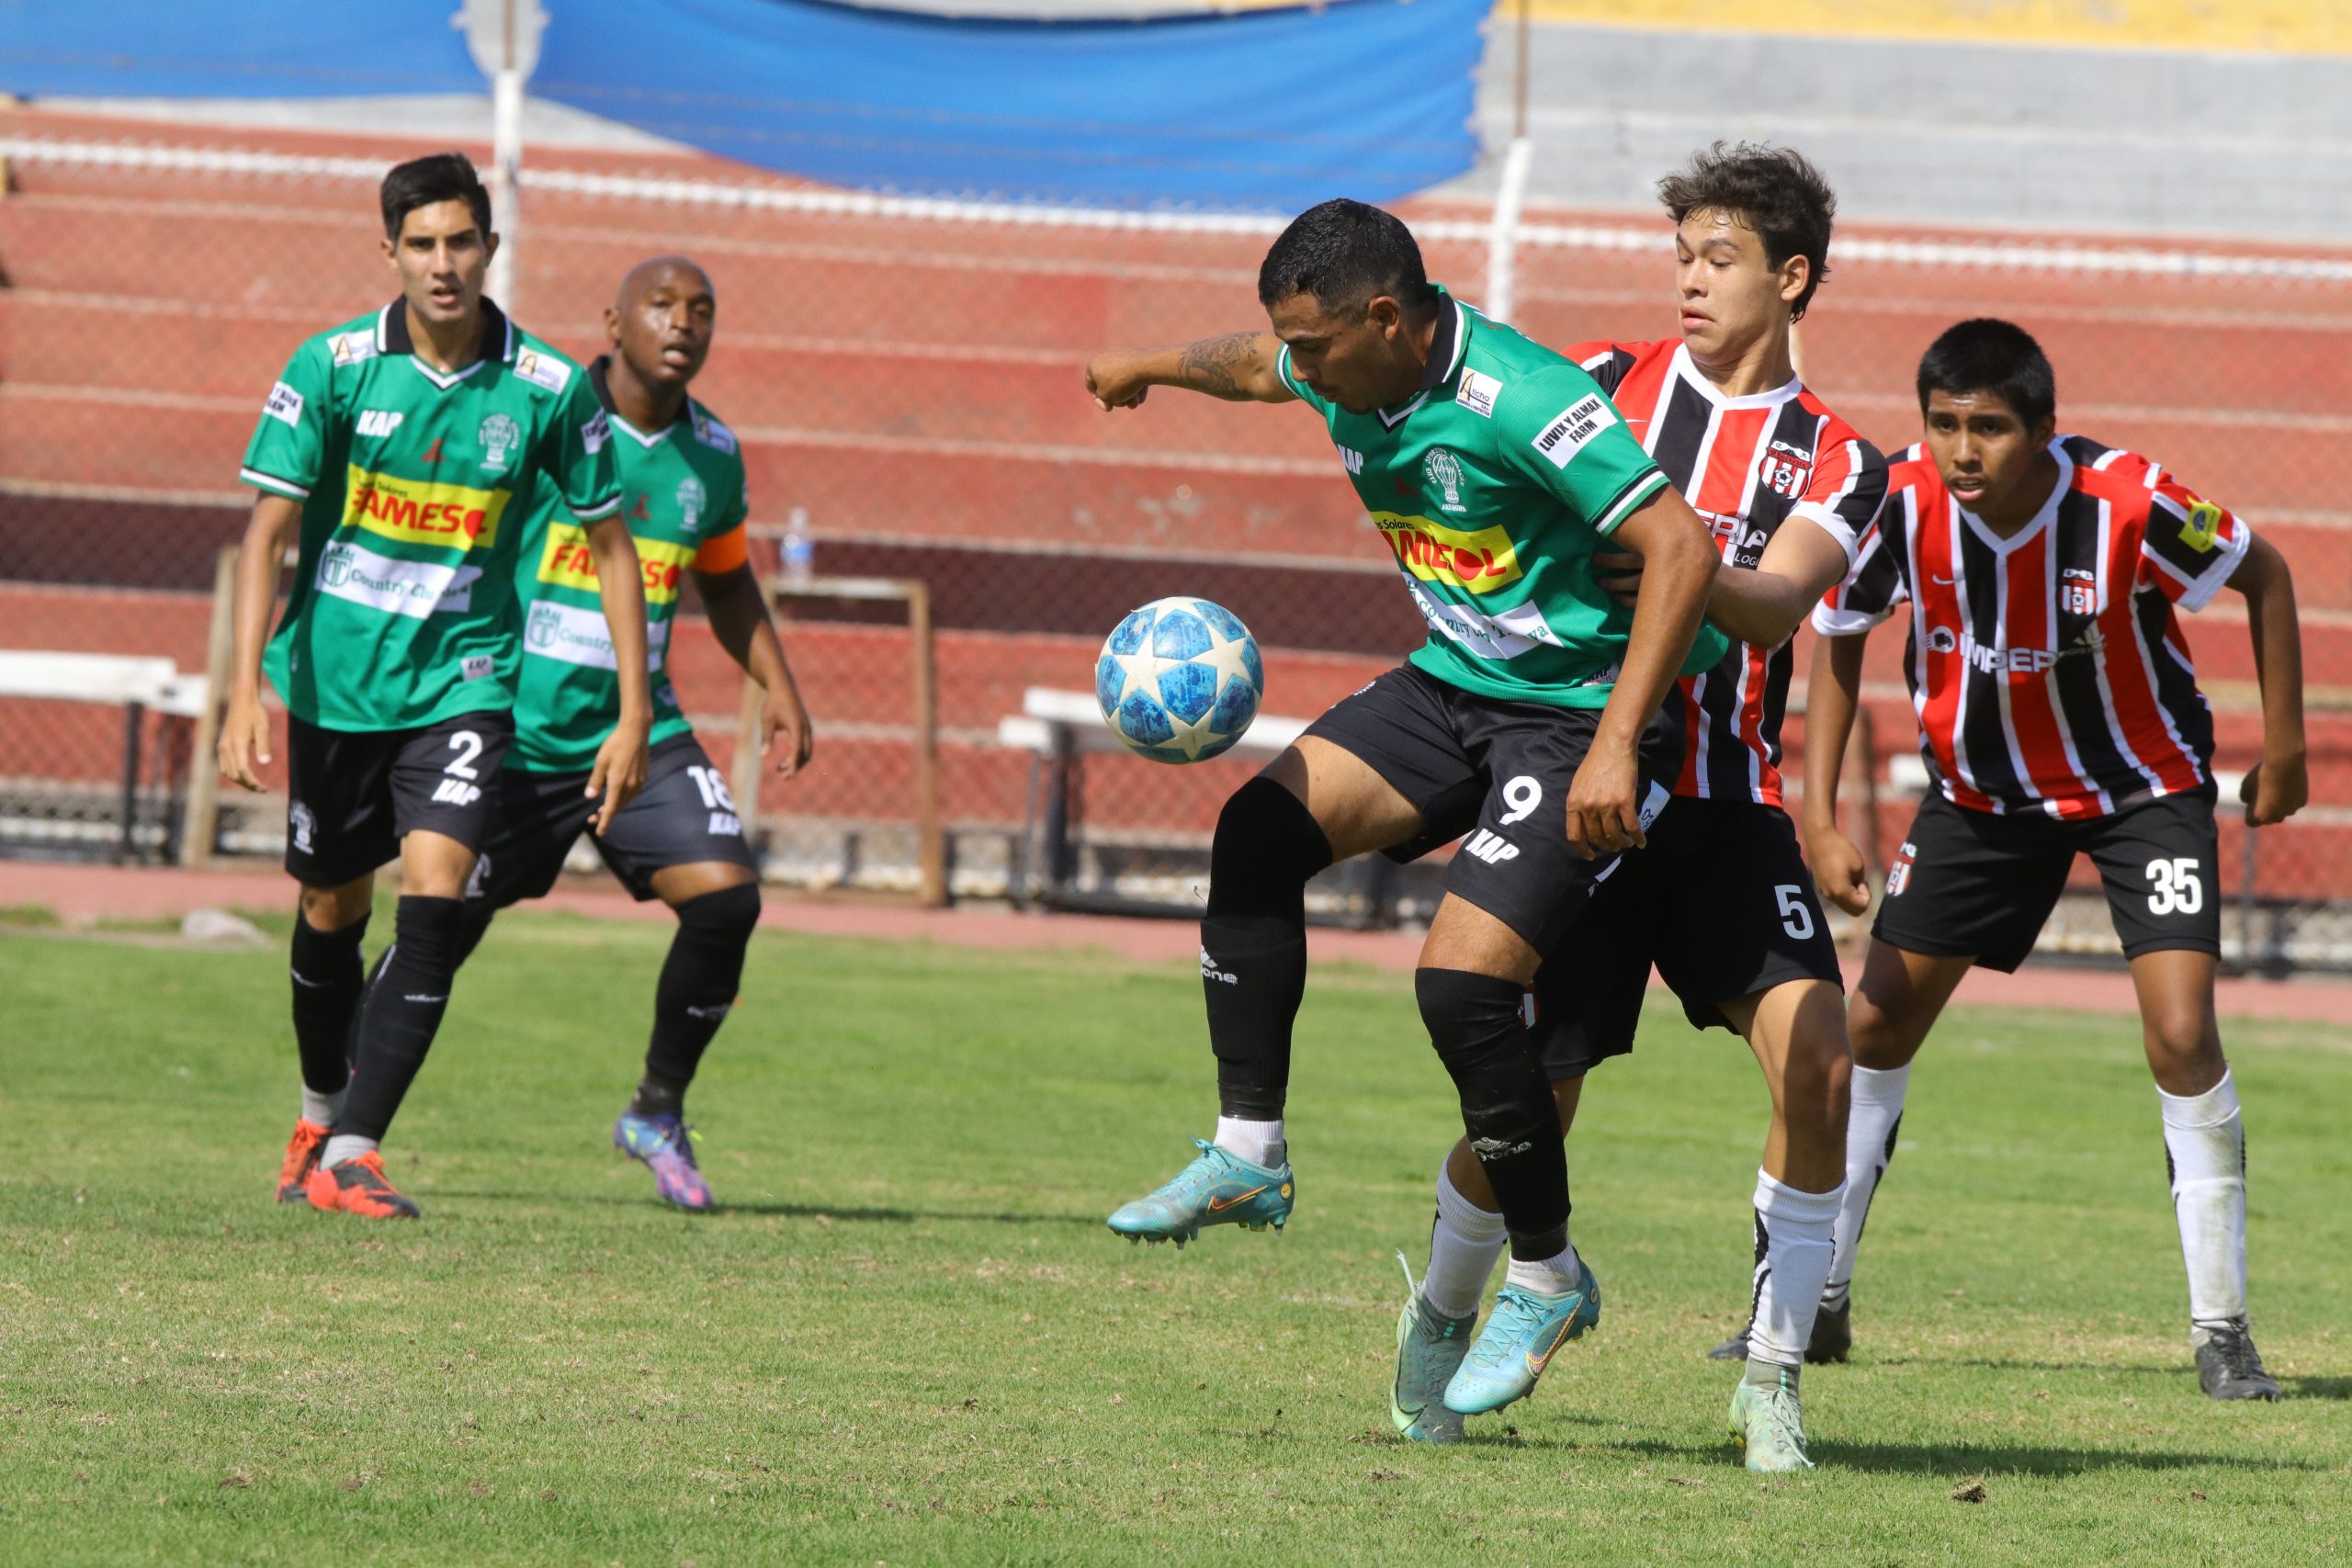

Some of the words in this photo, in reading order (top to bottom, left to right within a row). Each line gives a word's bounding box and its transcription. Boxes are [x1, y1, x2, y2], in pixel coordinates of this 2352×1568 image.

[356, 410, 404, 438] KAP
[1538, 422, 1570, 452] LUVIX
[1563, 415, 1576, 427] Y
[1571, 398, 1602, 423] ALMAX
[1568, 419, 1598, 444] FARM
[351, 569, 407, 597] Country
[444, 729, 483, 780] 2
[431, 778, 482, 807] KAP
[1498, 775, 1543, 826] 9
[1464, 828, 1521, 864] KAP
[2145, 857, 2203, 915] 35
[1774, 884, 1815, 940] 5
